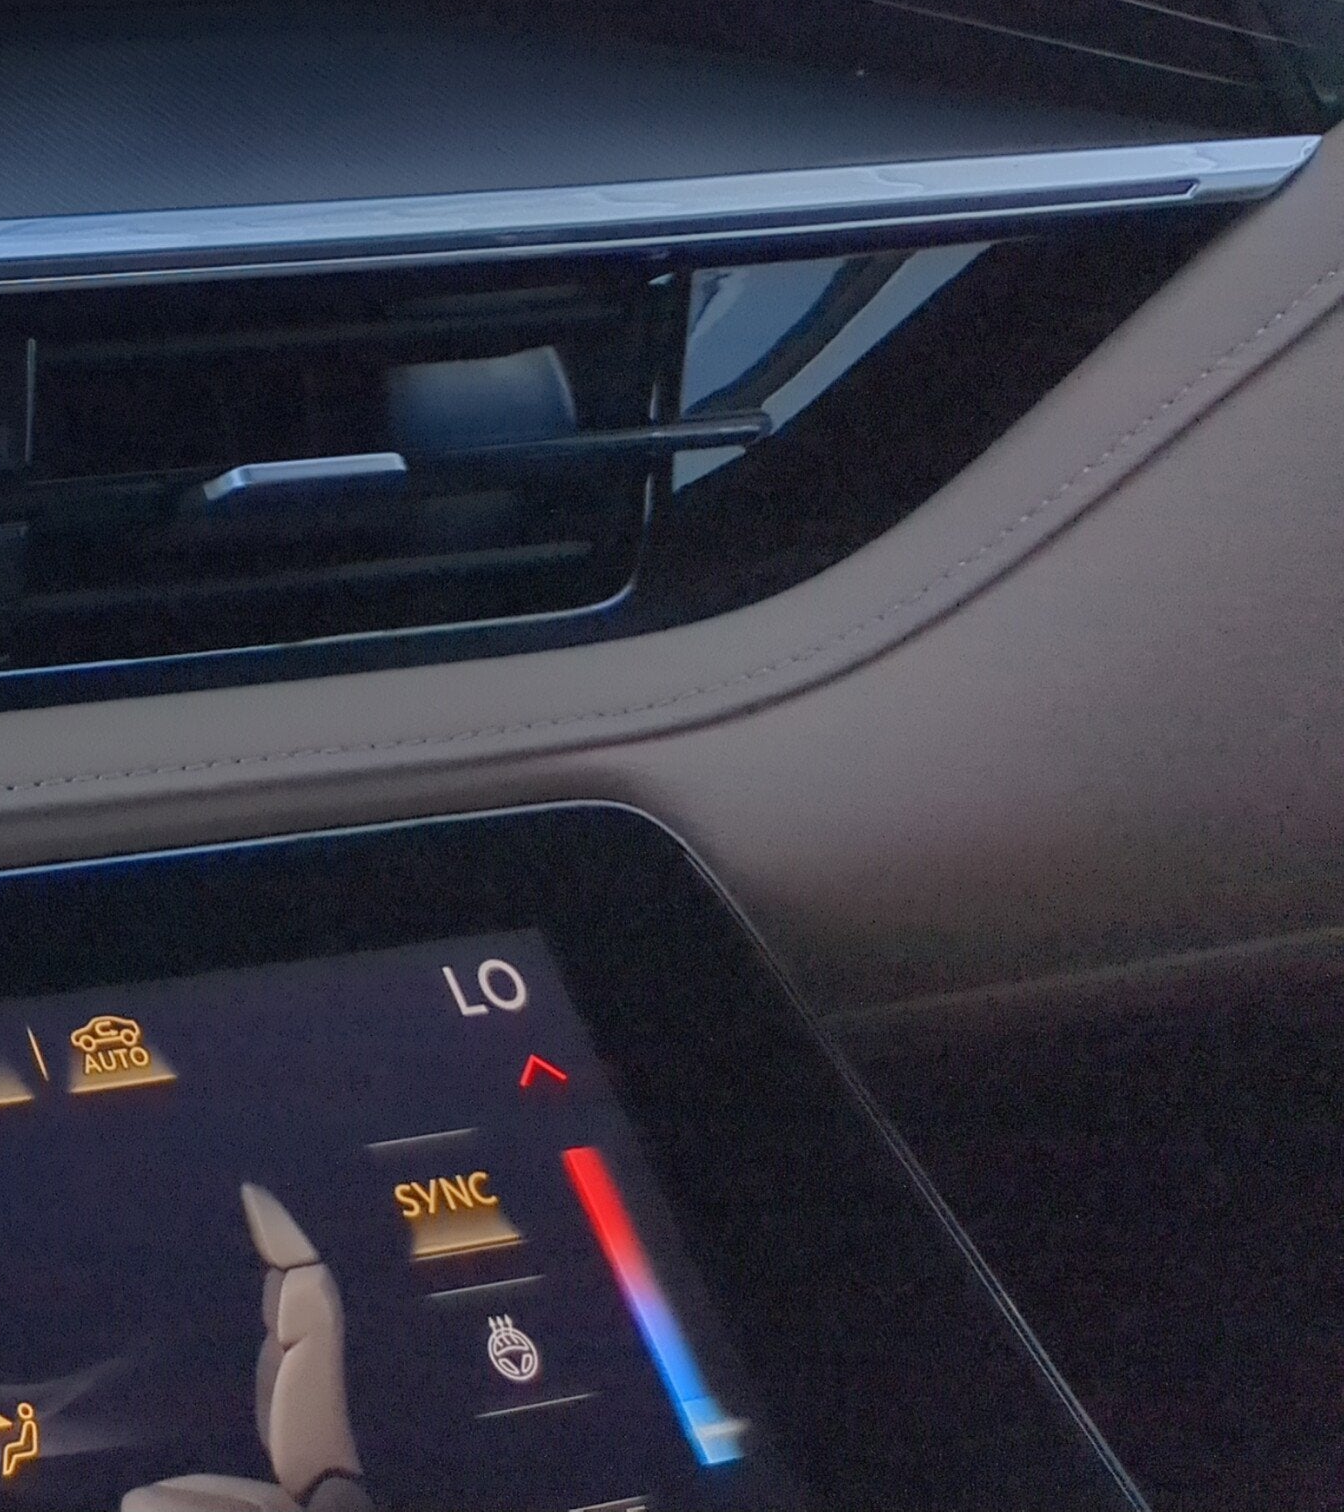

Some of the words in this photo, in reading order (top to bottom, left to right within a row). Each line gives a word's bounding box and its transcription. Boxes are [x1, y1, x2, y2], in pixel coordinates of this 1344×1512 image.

[442, 958, 527, 1017] LO
[80, 1044, 152, 1075] AUTO
[393, 1171, 499, 1219] SYNC
